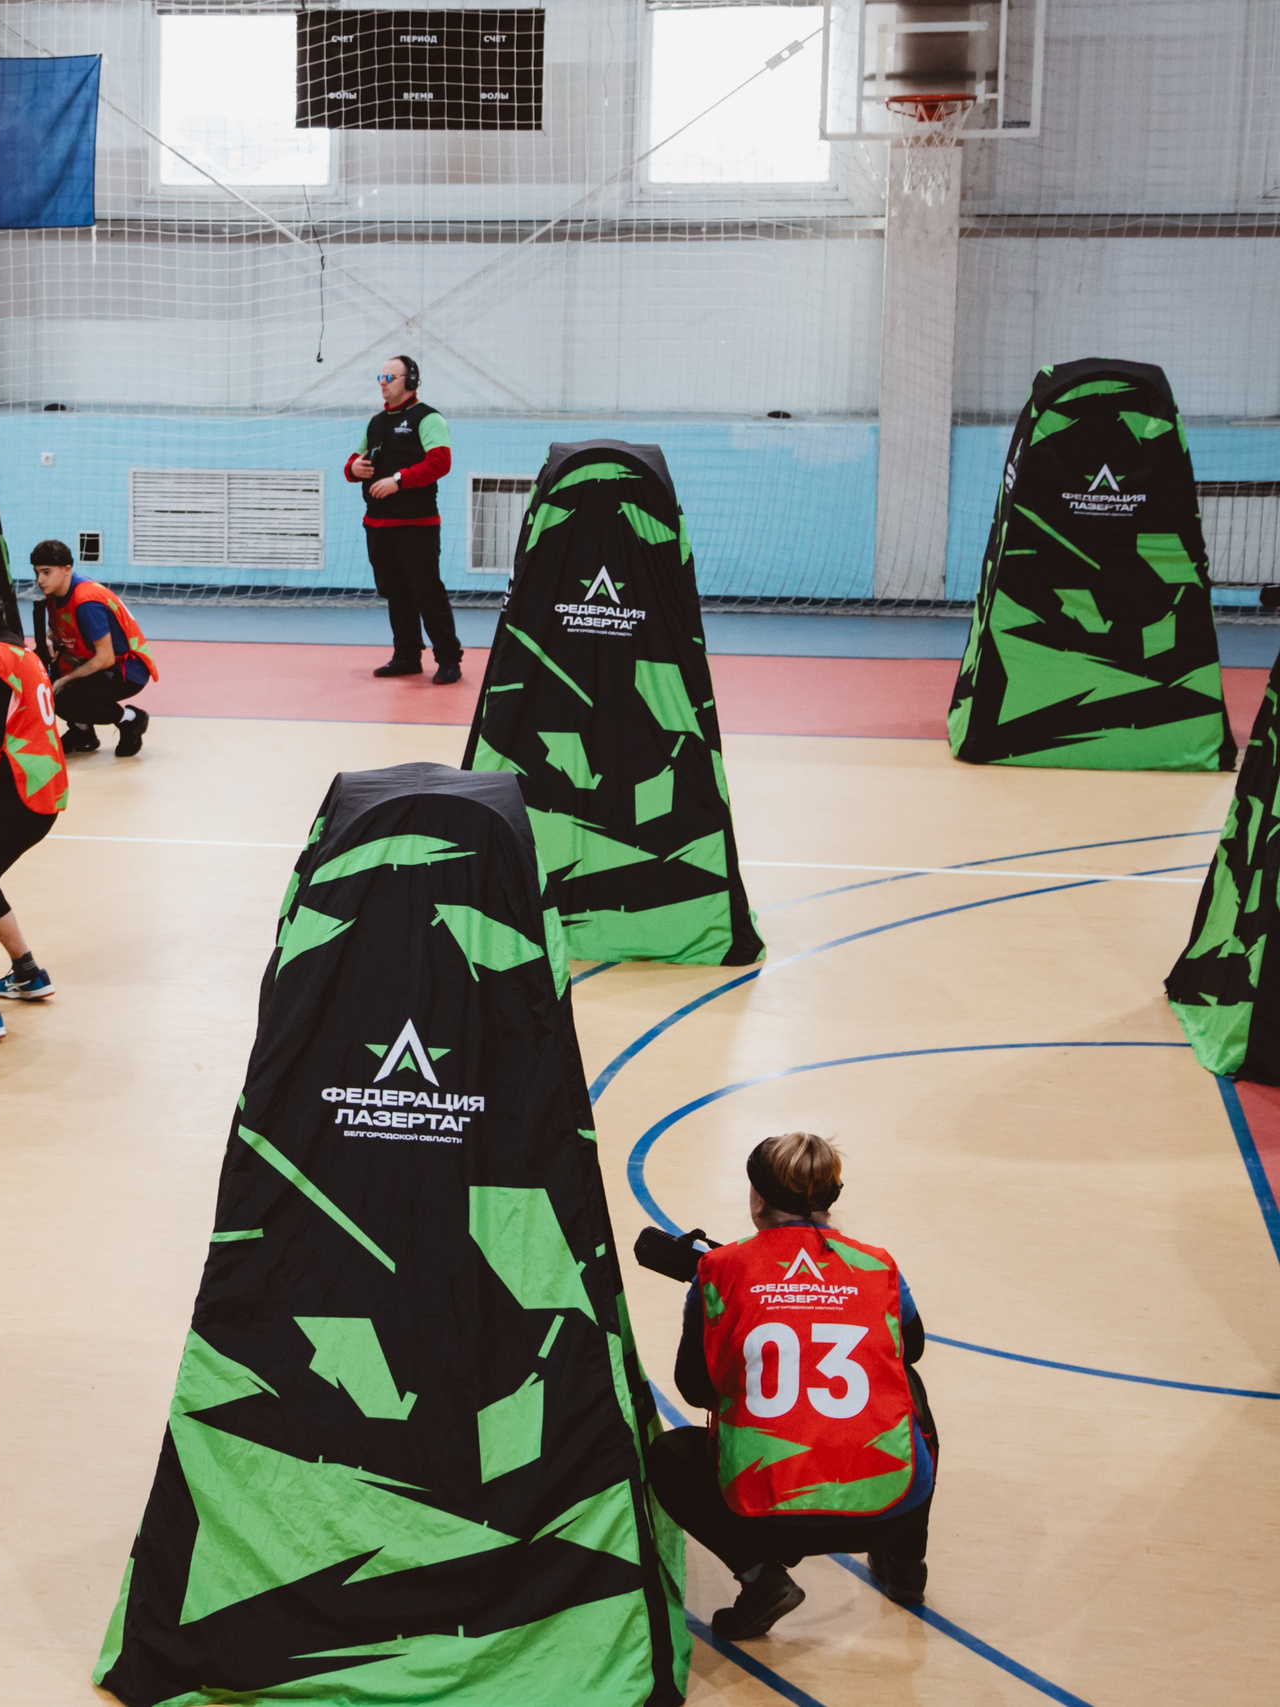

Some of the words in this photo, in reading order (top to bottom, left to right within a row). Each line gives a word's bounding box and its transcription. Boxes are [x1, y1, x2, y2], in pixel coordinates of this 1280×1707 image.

[331, 35, 354, 43] СЧЕТ
[400, 35, 437, 44] ПЕРИОД
[483, 35, 506, 43] СЧЕТ
[403, 92, 433, 100] ВРЕМЯ
[1061, 492, 1147, 502] ФЕДЕРАЦИЯ
[1069, 501, 1138, 512] ЛАЗЕРТАГ
[554, 603, 646, 620] ФЕДЕРАЦИЯ
[562, 616, 637, 630] ЛАЗЕРТАГ
[321, 1087, 485, 1112] ФЕДЕРАЦИЯ
[334, 1108, 471, 1132] ЛАЗЕРТАГ
[343, 1130, 418, 1141] БЕЛГОРОДСКОЙ
[419, 1135, 463, 1144] ОБЛАСТИ
[750, 1283, 858, 1296] ФЕДЕРАЦИЯ
[760, 1294, 848, 1305] ЛАЗЕРТАГ
[743, 1322, 870, 1419] 03
